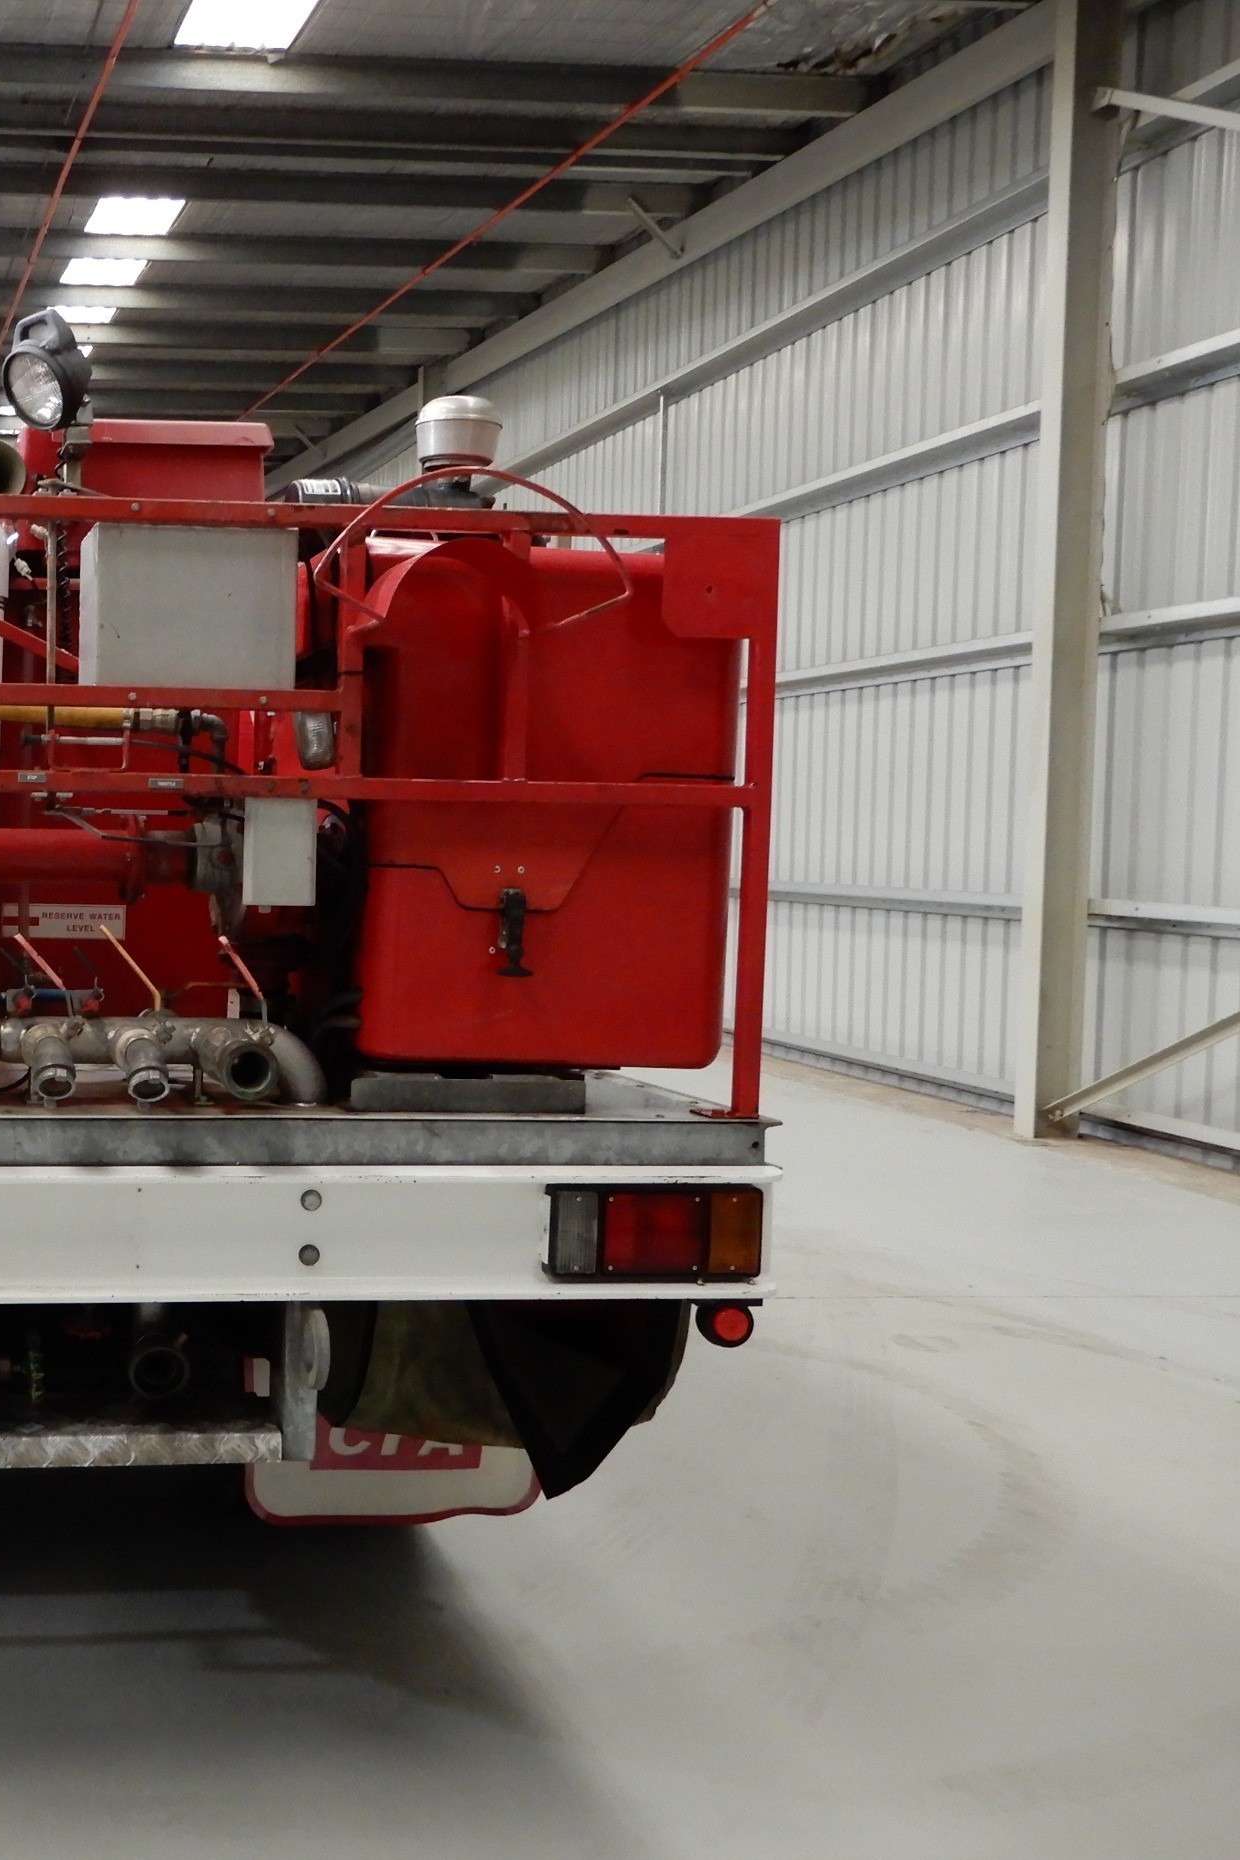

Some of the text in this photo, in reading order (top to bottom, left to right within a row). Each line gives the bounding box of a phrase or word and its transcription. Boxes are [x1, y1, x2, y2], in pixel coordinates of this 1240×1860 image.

[41, 911, 121, 921] RESERVE WATER
[66, 924, 95, 932] LEVEL
